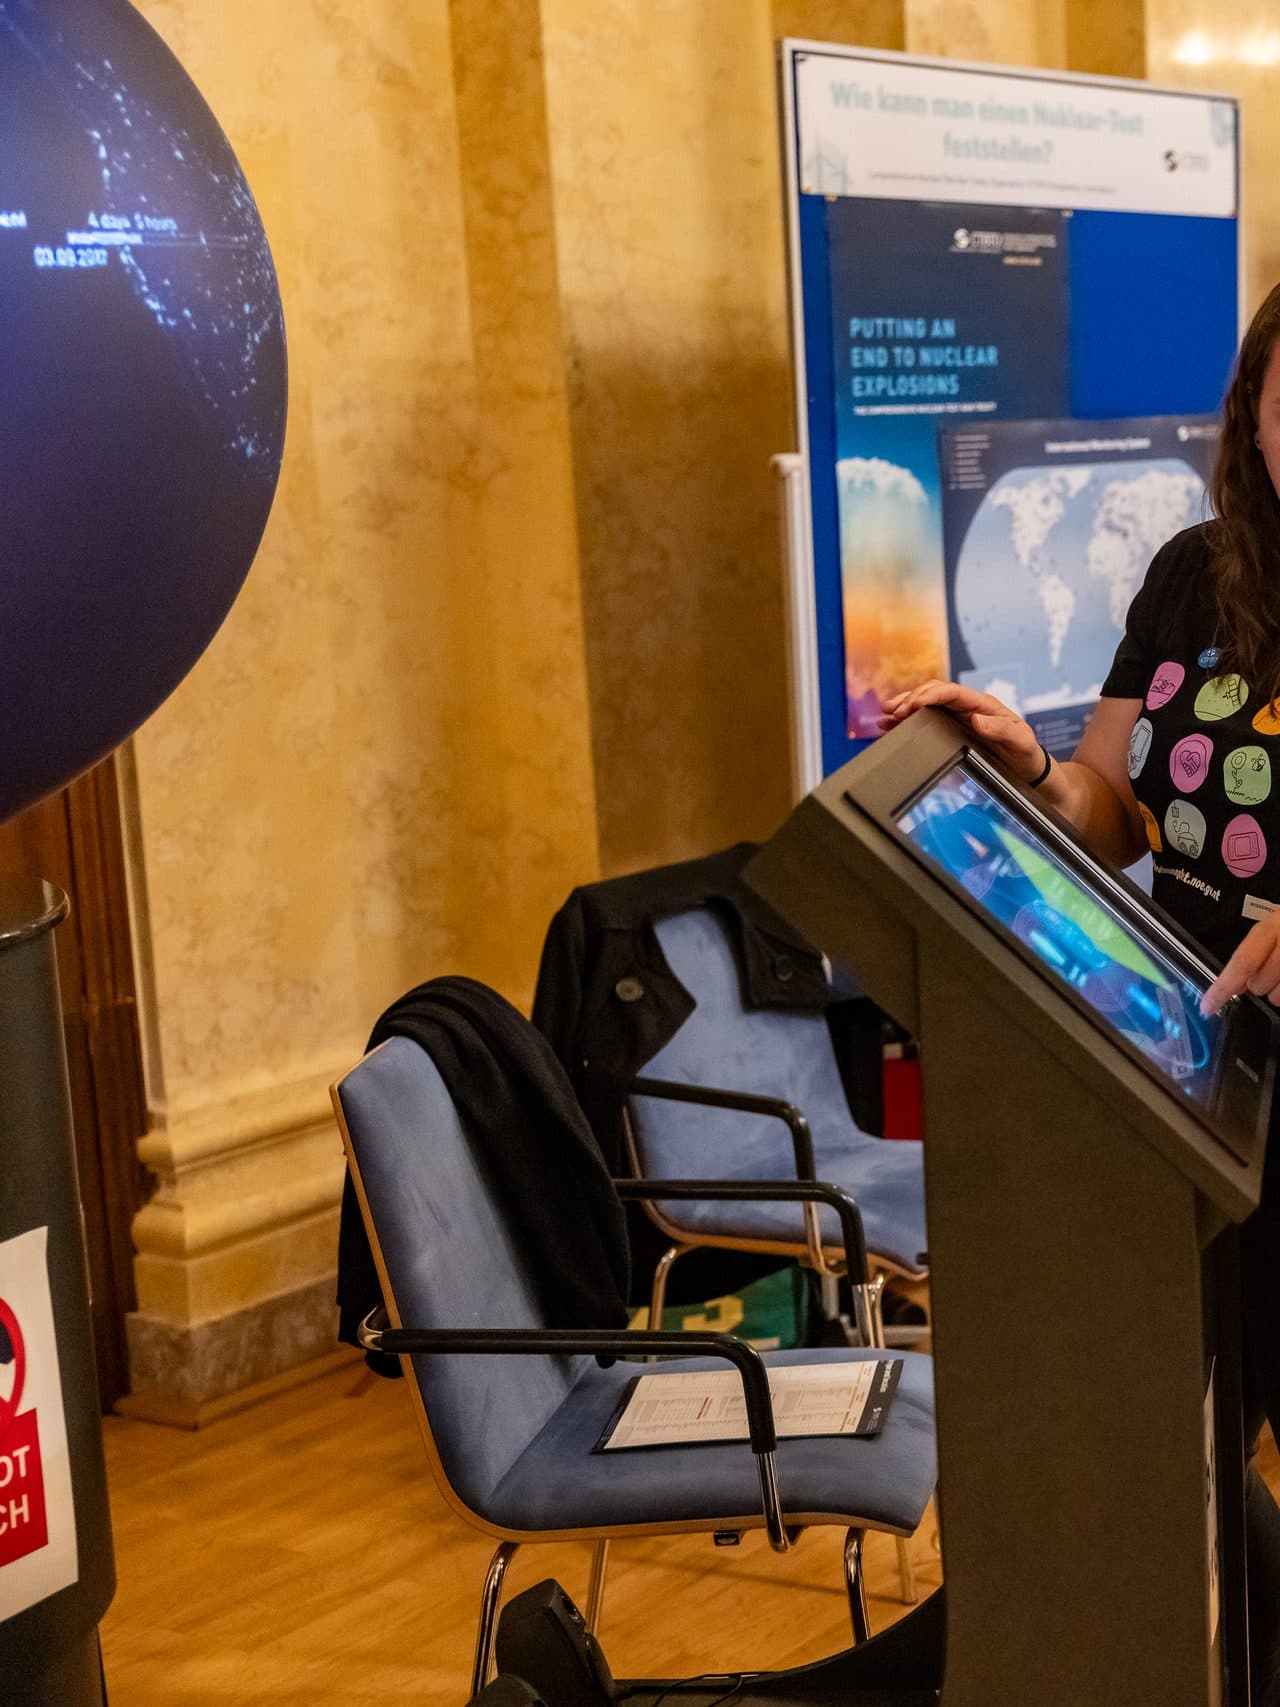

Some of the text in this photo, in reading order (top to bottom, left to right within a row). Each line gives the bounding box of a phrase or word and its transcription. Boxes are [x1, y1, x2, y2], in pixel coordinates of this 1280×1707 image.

[831, 80, 873, 110] Wie
[878, 84, 928, 114] kann
[932, 97, 974, 119] man
[979, 97, 1029, 124] einen
[944, 130, 1053, 164] feststellen?
[849, 317, 956, 339] PUTTING AN
[850, 345, 999, 368] END TO NUCLEAR
[852, 374, 960, 397] EXPLOSIONS
